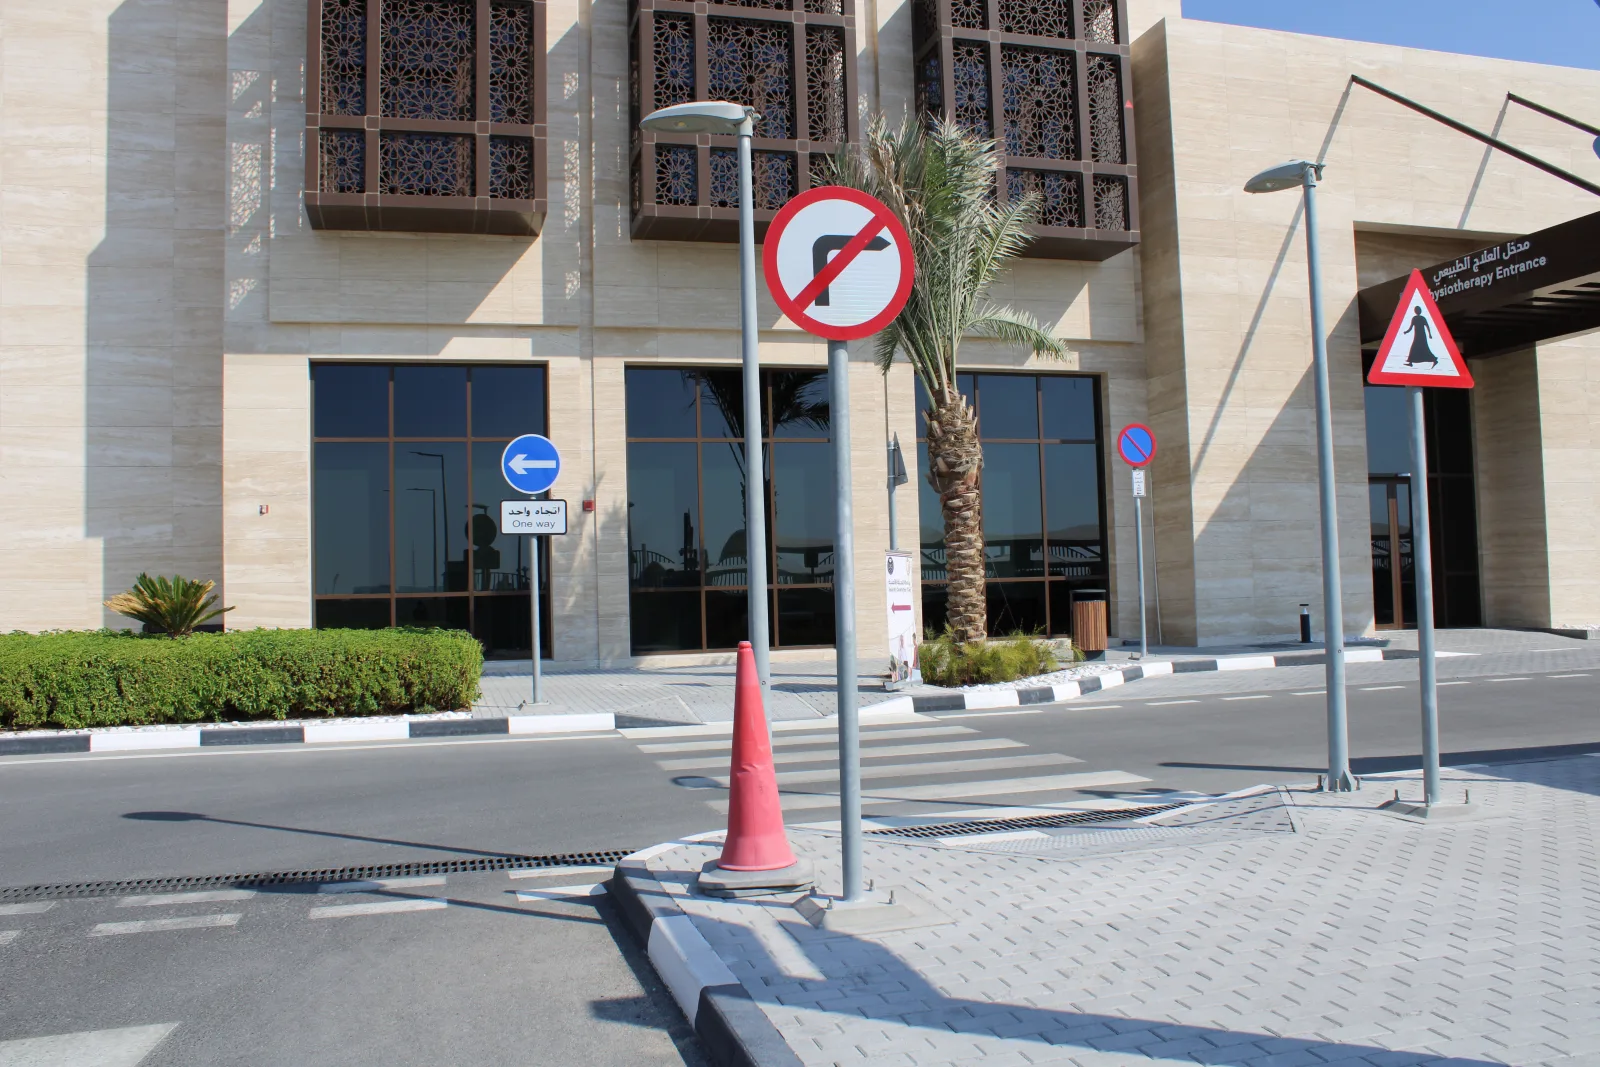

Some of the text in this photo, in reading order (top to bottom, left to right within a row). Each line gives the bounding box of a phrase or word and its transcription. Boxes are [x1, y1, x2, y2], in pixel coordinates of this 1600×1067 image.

[1433, 240, 1531, 286] مدخل العلاج الطبيعي
[1428, 256, 1548, 302] hysiotherapy Entrance
[508, 506, 560, 517] اتجاه واحد
[512, 519, 556, 530] One way
